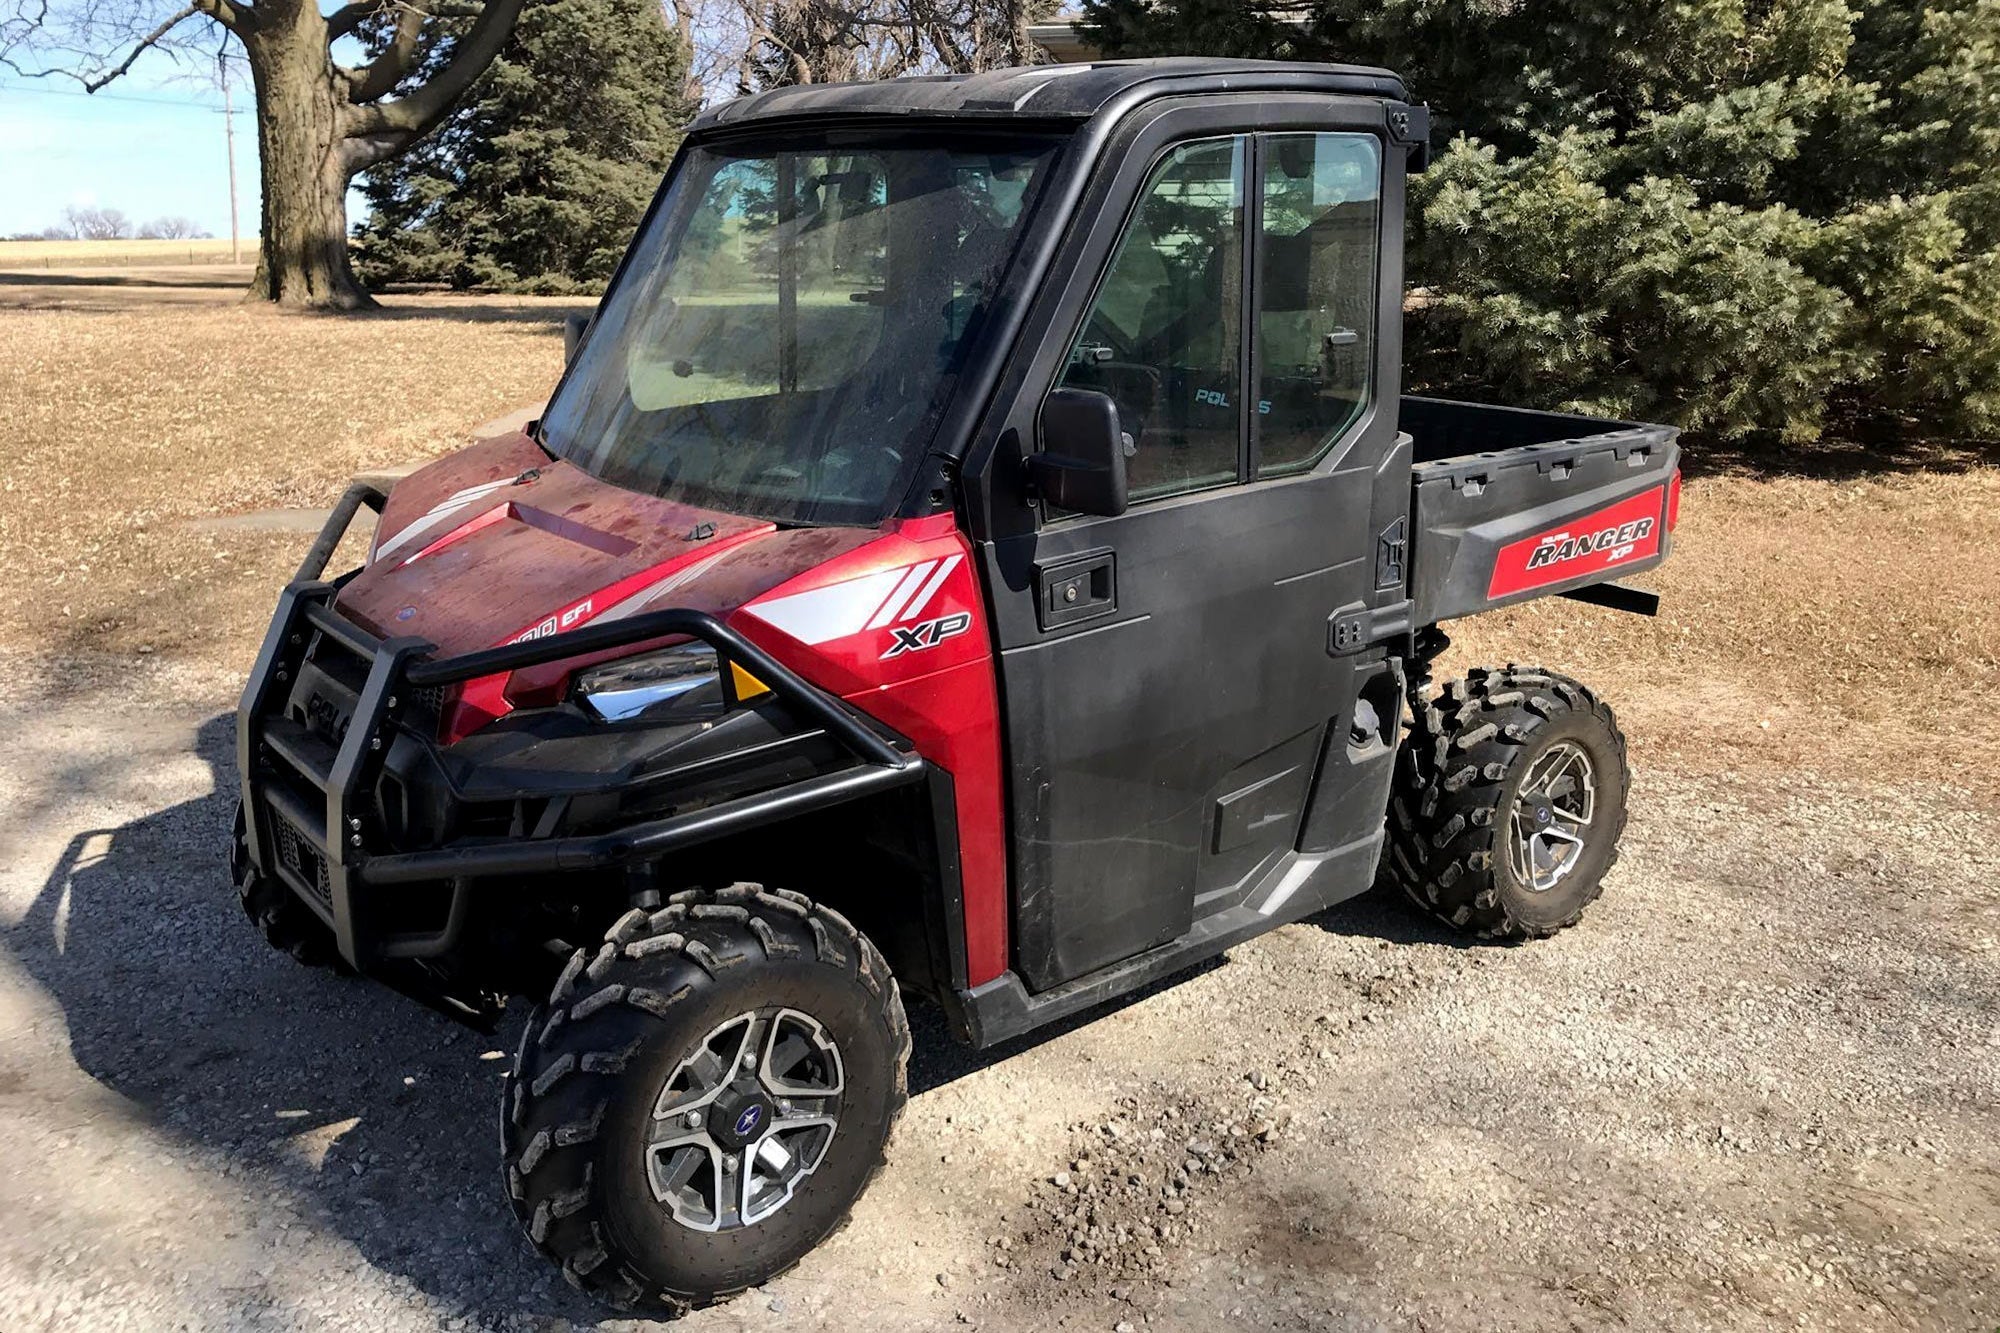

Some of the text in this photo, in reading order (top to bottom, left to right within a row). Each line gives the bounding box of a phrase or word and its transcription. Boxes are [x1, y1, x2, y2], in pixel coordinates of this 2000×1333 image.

[1525, 517, 1654, 571] RANGER
[1606, 544, 1634, 562] XP
[562, 598, 592, 627] EFI
[878, 611, 972, 660] XP
